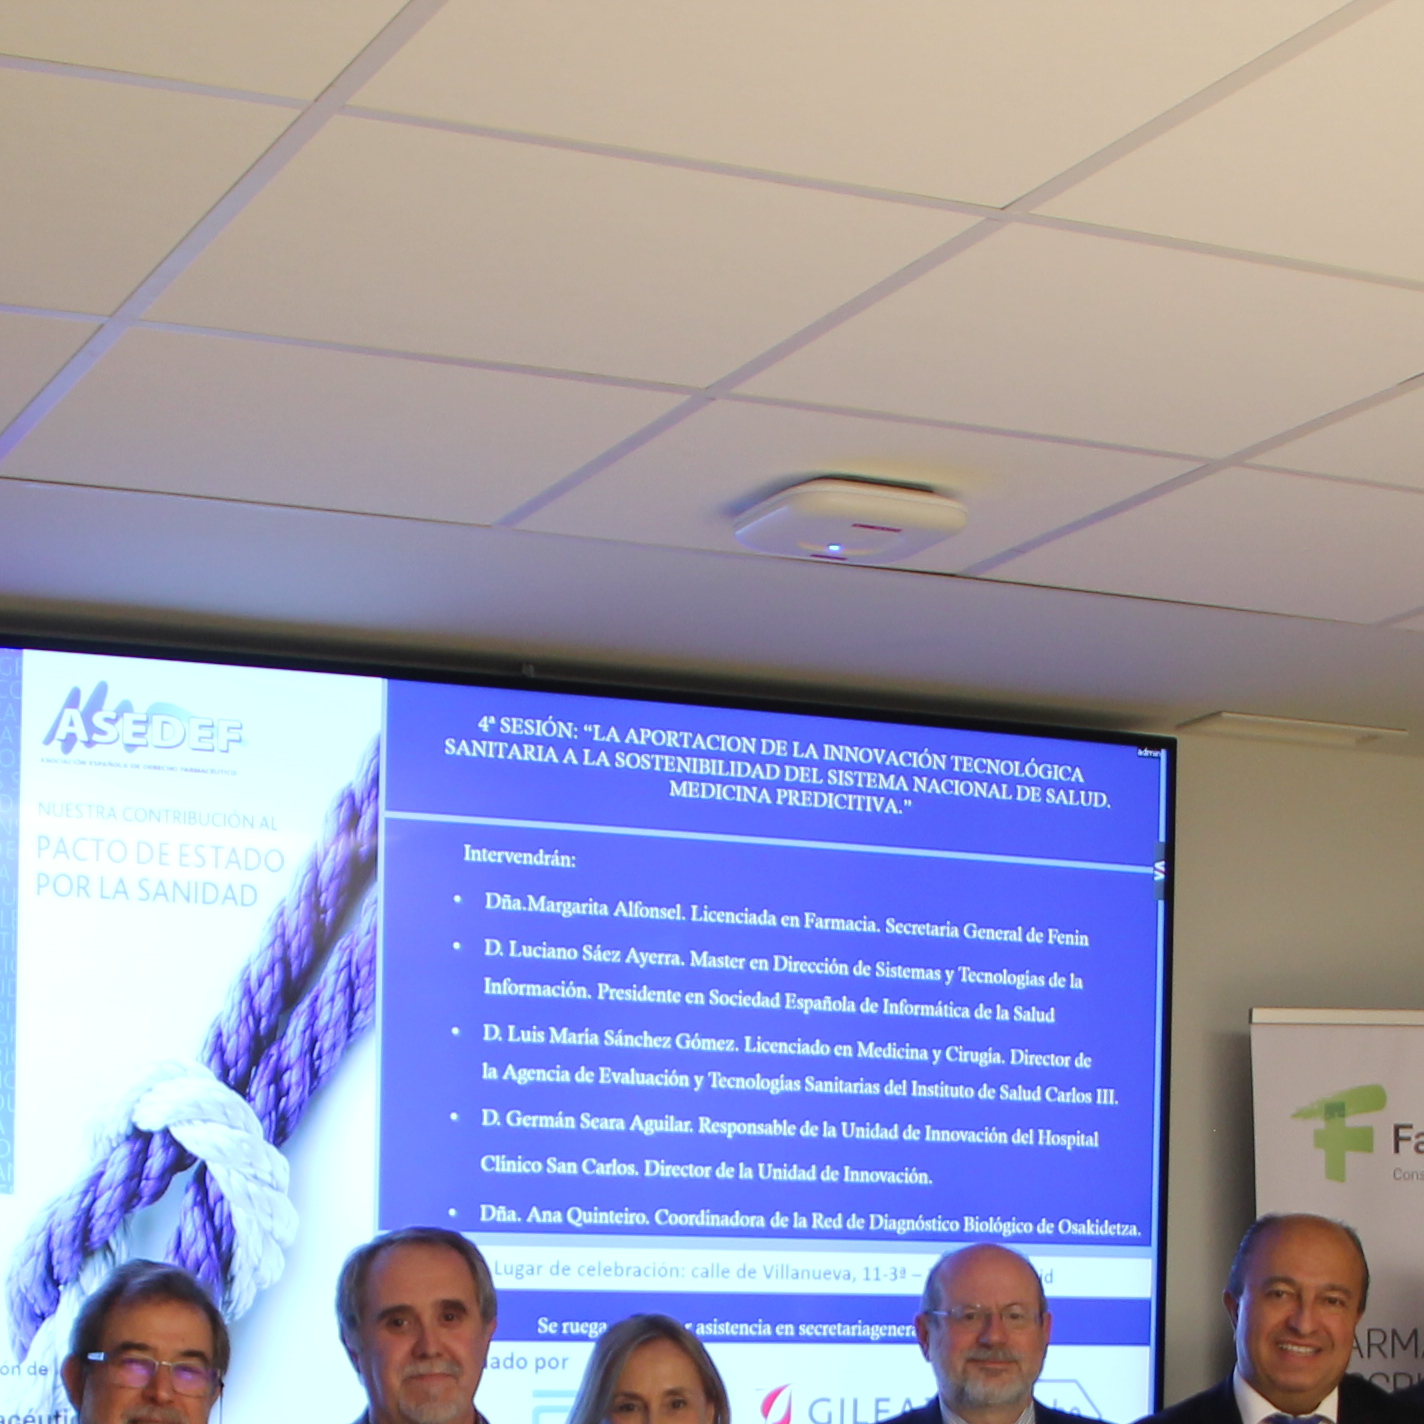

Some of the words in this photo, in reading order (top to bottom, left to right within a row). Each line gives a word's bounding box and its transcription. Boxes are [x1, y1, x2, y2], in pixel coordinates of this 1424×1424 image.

[55, 707, 244, 753] ASEDEF
[478, 716, 495, 731] 4ª
[500, 717, 577, 738] SESIÓN:
[584, 724, 620, 742] “LA
[624, 728, 756, 753] APORTACION
[761, 738, 787, 755] DE
[793, 741, 818, 759] LA
[823, 744, 946, 769] INNOVACIÓN
[950, 755, 1083, 782] TECNOLÓGICA
[445, 738, 558, 762] SANITARIA
[563, 748, 578, 764] A
[583, 748, 610, 766] LA
[614, 752, 780, 779] SOSTENIBILIDAD
[784, 765, 822, 783] DEL
[828, 769, 908, 790] SISTEMA
[913, 776, 1012, 799] NACIONAL
[1016, 785, 1041, 801] DE
[1046, 788, 1110, 807] SALUD.
[670, 780, 771, 803] MEDICINA
[776, 788, 911, 813] PREDICITIVA.”
[38, 801, 117, 820] NUESTRA
[122, 806, 254, 829] CONTRIBUCIÓN
[259, 816, 278, 831] AL
[37, 834, 128, 863] PACTO
[136, 841, 170, 866] DE
[178, 843, 285, 873] ESTADO
[464, 844, 575, 867] Intervendrán:
[36, 872, 91, 899] POR
[100, 875, 129, 900] LA
[138, 878, 258, 907] SANIDAD
[485, 892, 608, 917] Dña.Margarita
[613, 900, 685, 920] Alfonsel.
[691, 904, 776, 925] Licenciada
[780, 915, 799, 927] en
[804, 912, 880, 931] Farmacia.
[886, 918, 958, 937] Secretaria
[963, 923, 1022, 941] General
[1026, 927, 1043, 942] de
[1048, 928, 1088, 945] Fenin
[484, 938, 503, 955] D.
[509, 940, 577, 959] Luciano
[582, 944, 620, 962] Sáez
[625, 947, 684, 967] Ayerra.
[690, 950, 745, 969] Master
[750, 958, 768, 970] en
[773, 955, 848, 975] Dirección
[852, 960, 870, 976] de
[876, 961, 940, 979] Sistemas
[945, 969, 954, 985] y
[958, 966, 1044, 989] Tecnologías
[1048, 972, 1066, 987] de
[1070, 973, 1082, 988] la
[484, 977, 591, 998] Información.
[598, 983, 680, 1003] Presidente
[685, 992, 704, 1004] en
[709, 989, 780, 1007] Sociedad
[785, 992, 855, 1014] Española
[860, 997, 878, 1013] de
[883, 998, 970, 1017] Informática
[974, 1003, 992, 1019] de
[996, 1004, 1009, 1020] la
[1014, 1006, 1054, 1022] Salud
[483, 1023, 502, 1041] D.
[508, 1024, 544, 1042] Luis
[548, 1026, 598, 1045] María
[604, 1029, 671, 1048] Sánchez
[675, 1033, 738, 1051] Gómez.
[744, 1035, 830, 1055] Licenciado
[834, 1044, 852, 1056] en
[857, 1041, 928, 1059] Medicina
[932, 1049, 941, 1064] y
[946, 1045, 1004, 1067] Cirugía.
[1010, 1049, 1070, 1066] Director
[1074, 1052, 1091, 1067] de
[482, 1062, 498, 1079] la
[502, 1064, 570, 1084] Agencia
[574, 1065, 594, 1082] de
[598, 1066, 689, 1086] Evaluación
[694, 1075, 704, 1091] y
[708, 1071, 800, 1094] Tecnologías
[804, 1076, 879, 1093] Sanitarias
[884, 1079, 906, 1095] del
[911, 1080, 974, 1097] Instituto
[978, 1083, 995, 1099] de
[1000, 1084, 1041, 1101] Salud
[1045, 1087, 1091, 1102] Carlos
[1096, 1088, 1118, 1104] III.
[482, 1108, 500, 1125] D.
[506, 1110, 575, 1128] Germán
[580, 1112, 624, 1130] Seara
[629, 1114, 692, 1135] Aguilar.
[698, 1116, 796, 1138] Responsable
[800, 1120, 818, 1136] de
[822, 1121, 836, 1137] la
[841, 1122, 898, 1139] Unidad
[902, 1124, 920, 1140] de
[925, 1125, 1007, 1143] Innovación
[1012, 1128, 1033, 1144] del
[1038, 1129, 1098, 1149] Hospital
[480, 1154, 542, 1172] Clínico
[546, 1157, 577, 1173] San
[582, 1158, 638, 1175] Carlos.
[644, 1159, 711, 1177] Director
[715, 1161, 734, 1178] de
[739, 1162, 752, 1179] la
[758, 1163, 816, 1180] Unidad
[820, 1165, 839, 1181] de
[844, 1165, 932, 1183] Innovación.
[480, 1204, 521, 1221] Dña.
[526, 1206, 562, 1222] Ana
[566, 1206, 649, 1226] Quinteiro.
[654, 1208, 765, 1227] Coordinadora
[770, 1211, 788, 1227] de
[793, 1211, 807, 1227] la
[812, 1212, 842, 1229] Red
[846, 1213, 864, 1229] de
[869, 1213, 959, 1234] Diagnóstico
[964, 1216, 1032, 1236] Biológico
[1036, 1218, 1054, 1233] de
[1058, 1219, 1140, 1235] Osakidetza.
[494, 1260, 543, 1280] Lugar
[549, 1260, 571, 1277] de
[577, 1261, 686, 1279] celebración:
[691, 1262, 730, 1280] calle
[736, 1262, 757, 1280] de
[763, 1264, 857, 1283] Villanueva,
[537, 1317, 559, 1335] Se
[562, 1320, 607, 1338] ruega
[695, 1318, 772, 1336] asistencia
[775, 1322, 795, 1336] en
[798, 1319, 918, 1340] secretariagenera
[27, 1360, 49, 1376] de
[535, 1355, 570, 1374] por
